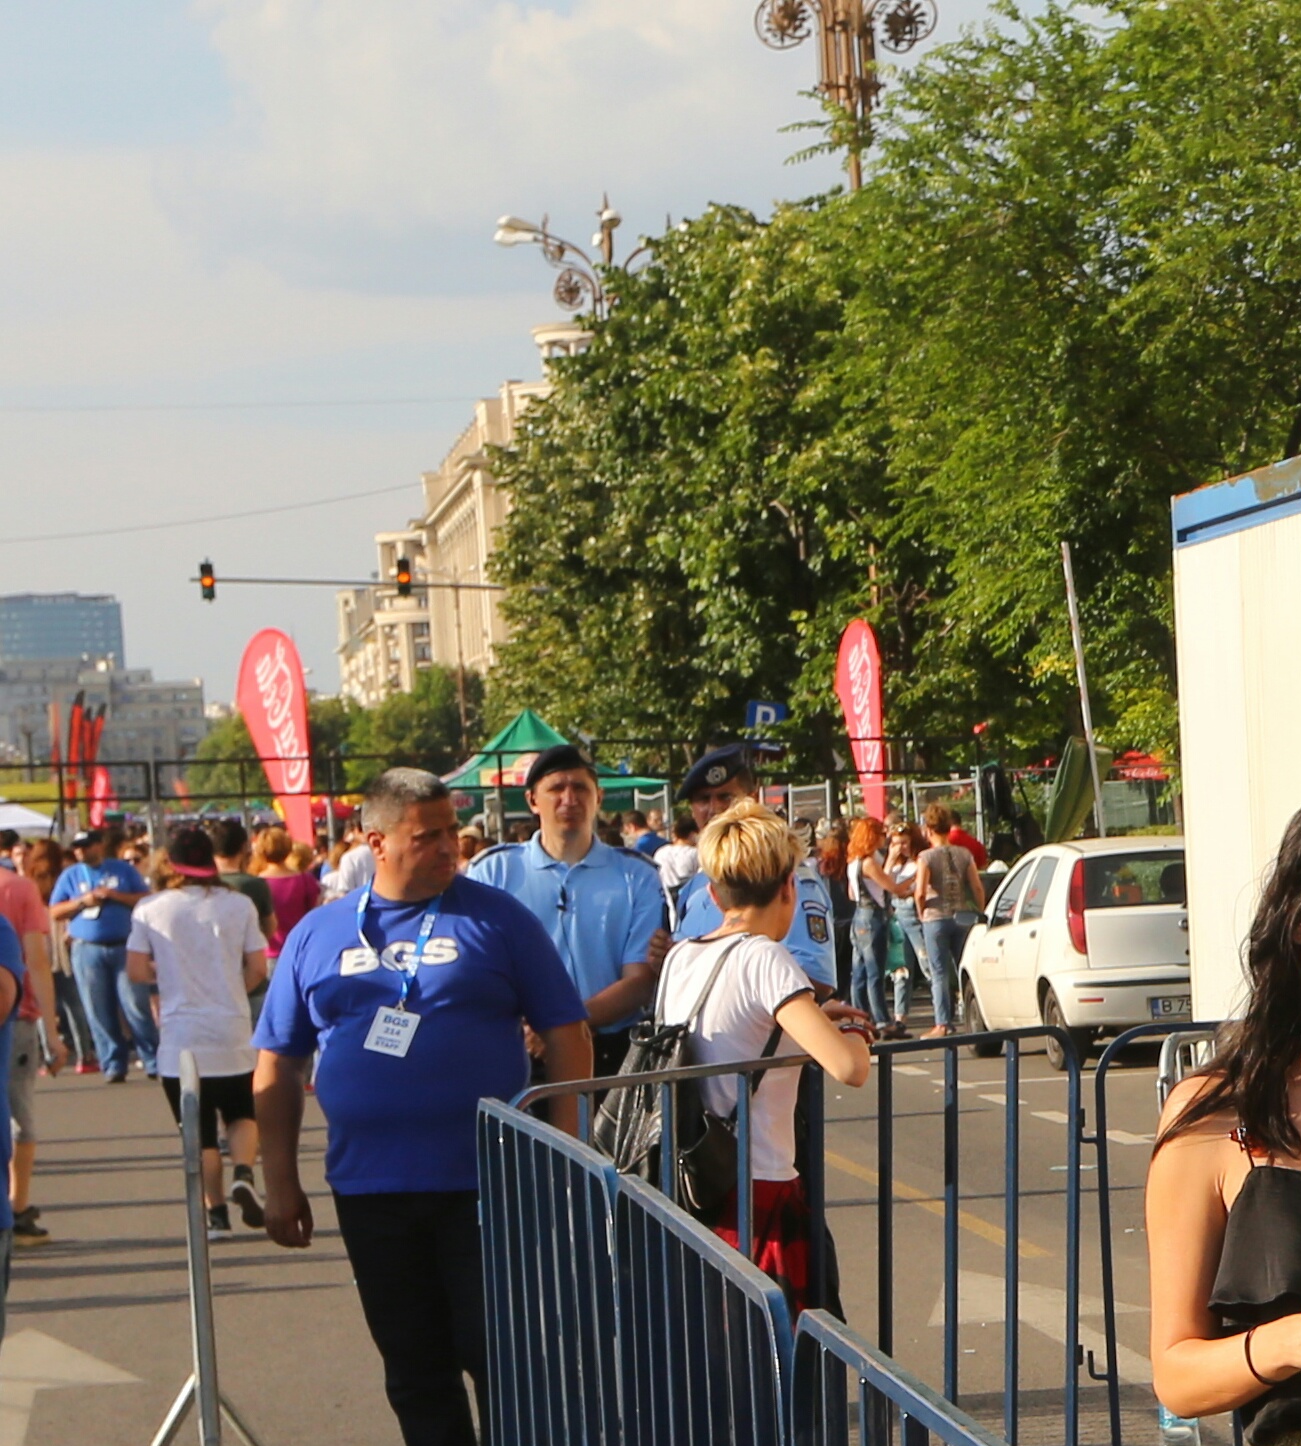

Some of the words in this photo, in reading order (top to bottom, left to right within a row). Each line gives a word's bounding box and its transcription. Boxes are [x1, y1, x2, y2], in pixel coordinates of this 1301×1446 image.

[755, 704, 776, 733] P
[340, 937, 459, 977] BGS
[383, 1014, 410, 1028] BGS
